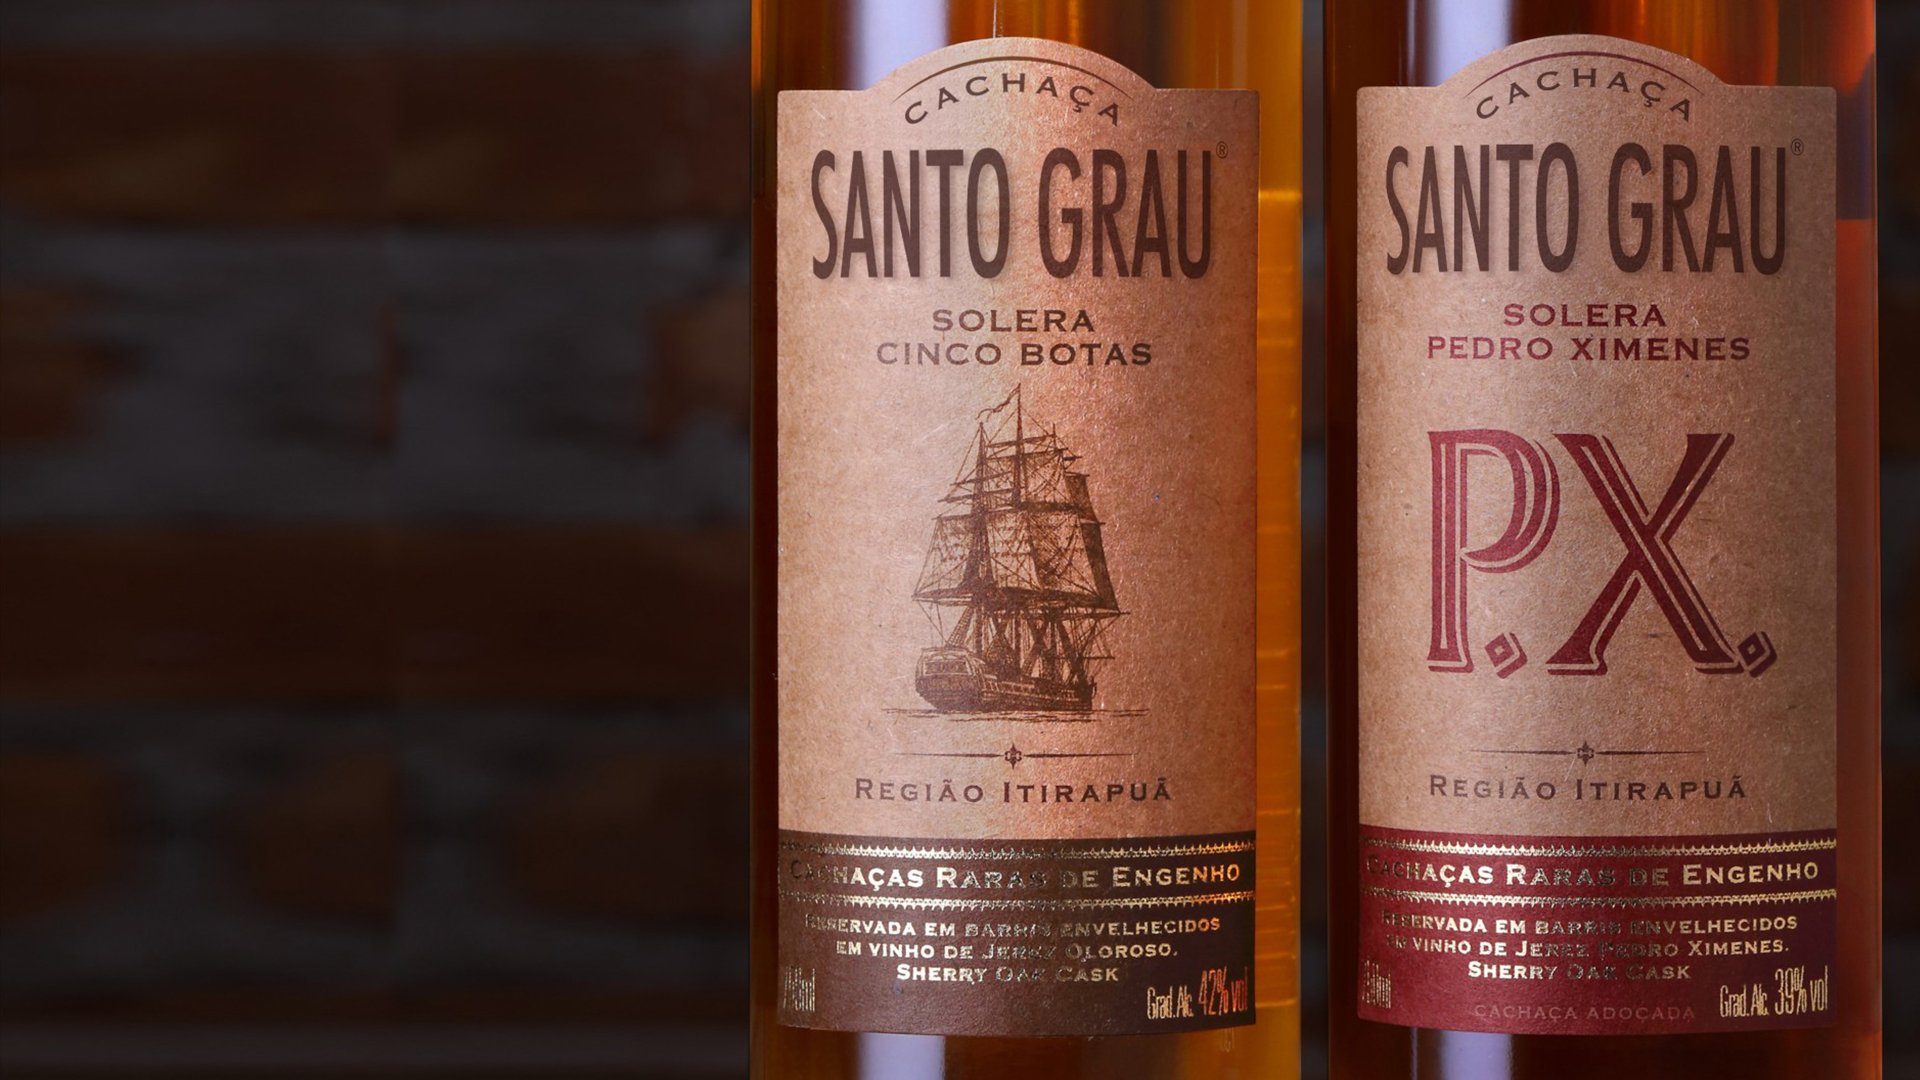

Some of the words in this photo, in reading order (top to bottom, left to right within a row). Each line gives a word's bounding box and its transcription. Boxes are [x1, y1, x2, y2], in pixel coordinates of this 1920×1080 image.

[904, 72, 1120, 126] CACHAÇA
[1476, 68, 1690, 122] CACHAÇA
[811, 147, 1010, 279] SANTO
[1038, 147, 1213, 279] GRAU
[1386, 142, 1580, 276] SANTO
[1607, 142, 1787, 276] GRAU
[933, 309, 1095, 333] SOLERA
[1503, 303, 1667, 327] SOLERA
[876, 342, 1002, 366] CINCO
[1020, 343, 1152, 366] BOTAS
[1427, 336, 1554, 360] PEDRO
[1570, 337, 1750, 361] XIMENES
[1426, 429, 1778, 678] P.X.
[855, 777, 984, 803] REGIÃO
[1429, 774, 1557, 801] REGIÃO
[790, 860, 924, 891] CACHAÇAS
[936, 866, 1047, 889] RARAS
[1062, 870, 1099, 888] DE
[1112, 863, 1240, 888] ENGENHO
[1366, 855, 1494, 888] CACHAÇAS
[1506, 863, 1616, 887] RARAS
[1629, 867, 1669, 886] DE
[1682, 861, 1819, 886] ENGENHO
[924, 922, 956, 937] EM
[1060, 917, 1221, 938] ENVELHECIDOS
[1495, 919, 1526, 934] EM
[1535, 920, 1622, 935] BARRIS
[1630, 916, 1798, 936] ENVELHECIDOS
[836, 940, 862, 957] EM
[868, 942, 935, 959] VINHO
[943, 945, 974, 960] DE
[1412, 937, 1472, 955] VINHO
[1479, 941, 1508, 957] DE
[1687, 939, 1790, 958] XIMENES.
[897, 964, 988, 984] SHERRY
[1056, 966, 1119, 982] CASK
[1468, 961, 1557, 980] SHERRY
[1626, 965, 1692, 980] CASK
[1199, 966, 1229, 1016] 42%
[1774, 965, 1807, 1016] 39%
[1810, 965, 1829, 1012] vol
[1474, 1004, 1578, 1023] CACHAÇA
